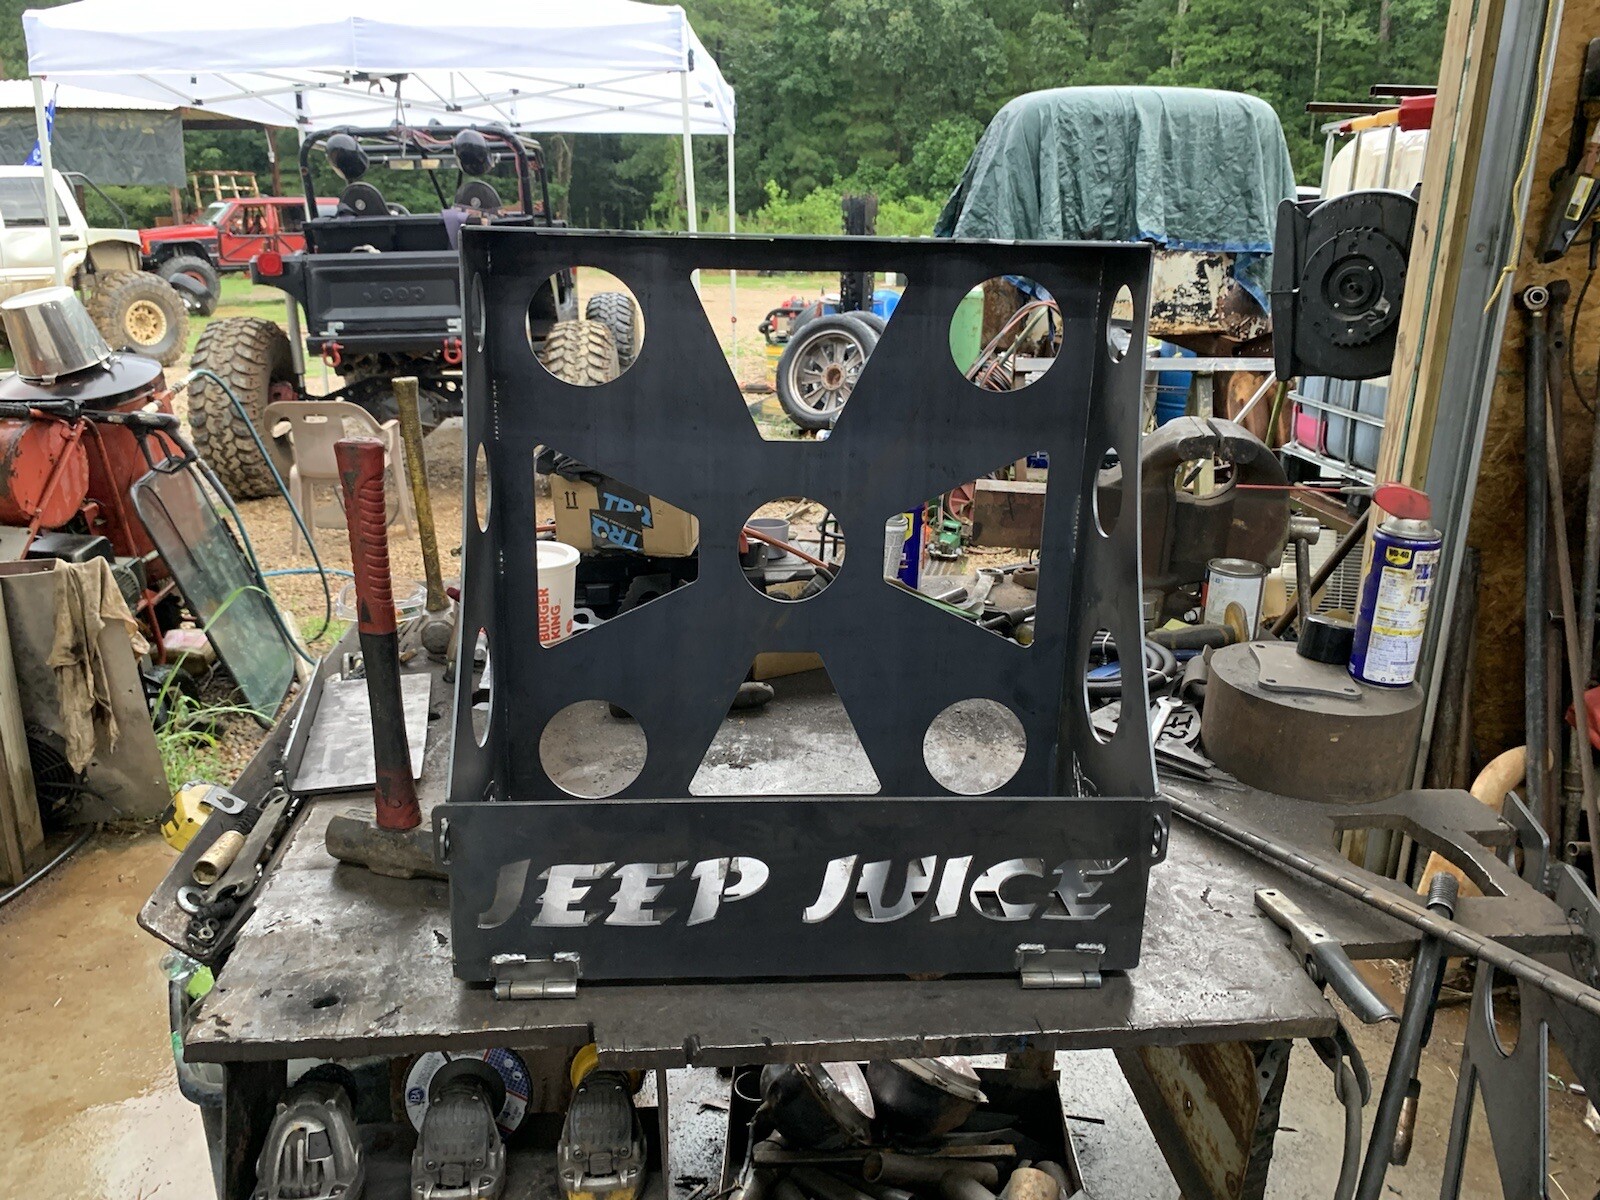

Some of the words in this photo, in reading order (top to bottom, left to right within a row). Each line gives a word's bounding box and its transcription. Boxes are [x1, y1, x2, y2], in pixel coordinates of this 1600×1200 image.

[591, 515, 639, 552] TRQ
[538, 588, 550, 641] BURGER
[551, 605, 561, 639] KING
[478, 856, 770, 929] JEEP
[802, 854, 1130, 922] JUICE
